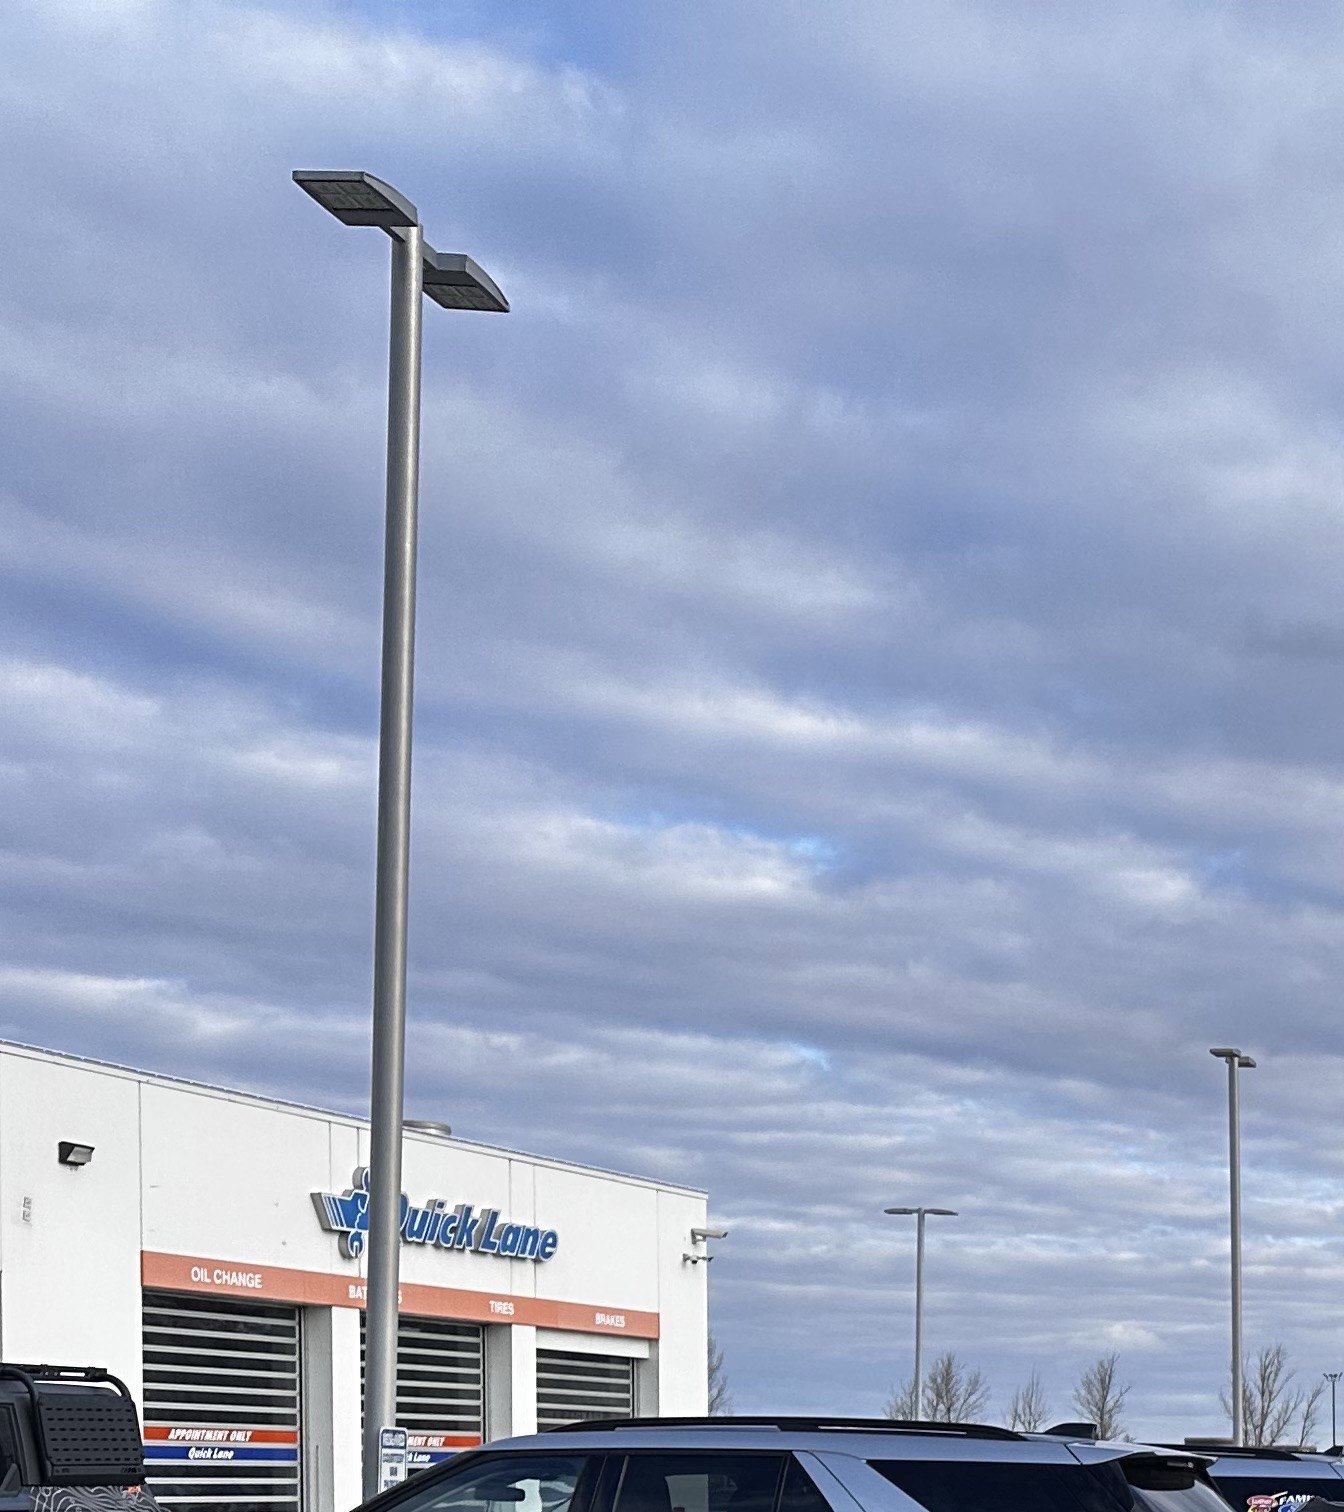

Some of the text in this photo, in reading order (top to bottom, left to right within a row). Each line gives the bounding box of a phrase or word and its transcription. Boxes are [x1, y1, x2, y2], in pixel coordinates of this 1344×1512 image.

[480, 1210, 559, 1262] Lane
[191, 1266, 263, 1289] OIL CHANGE
[489, 1300, 515, 1315] TIRES
[595, 1312, 625, 1328] BRAKES
[168, 1428, 253, 1442] APPOINTMENT ONLY
[188, 1446, 212, 1460] Quick
